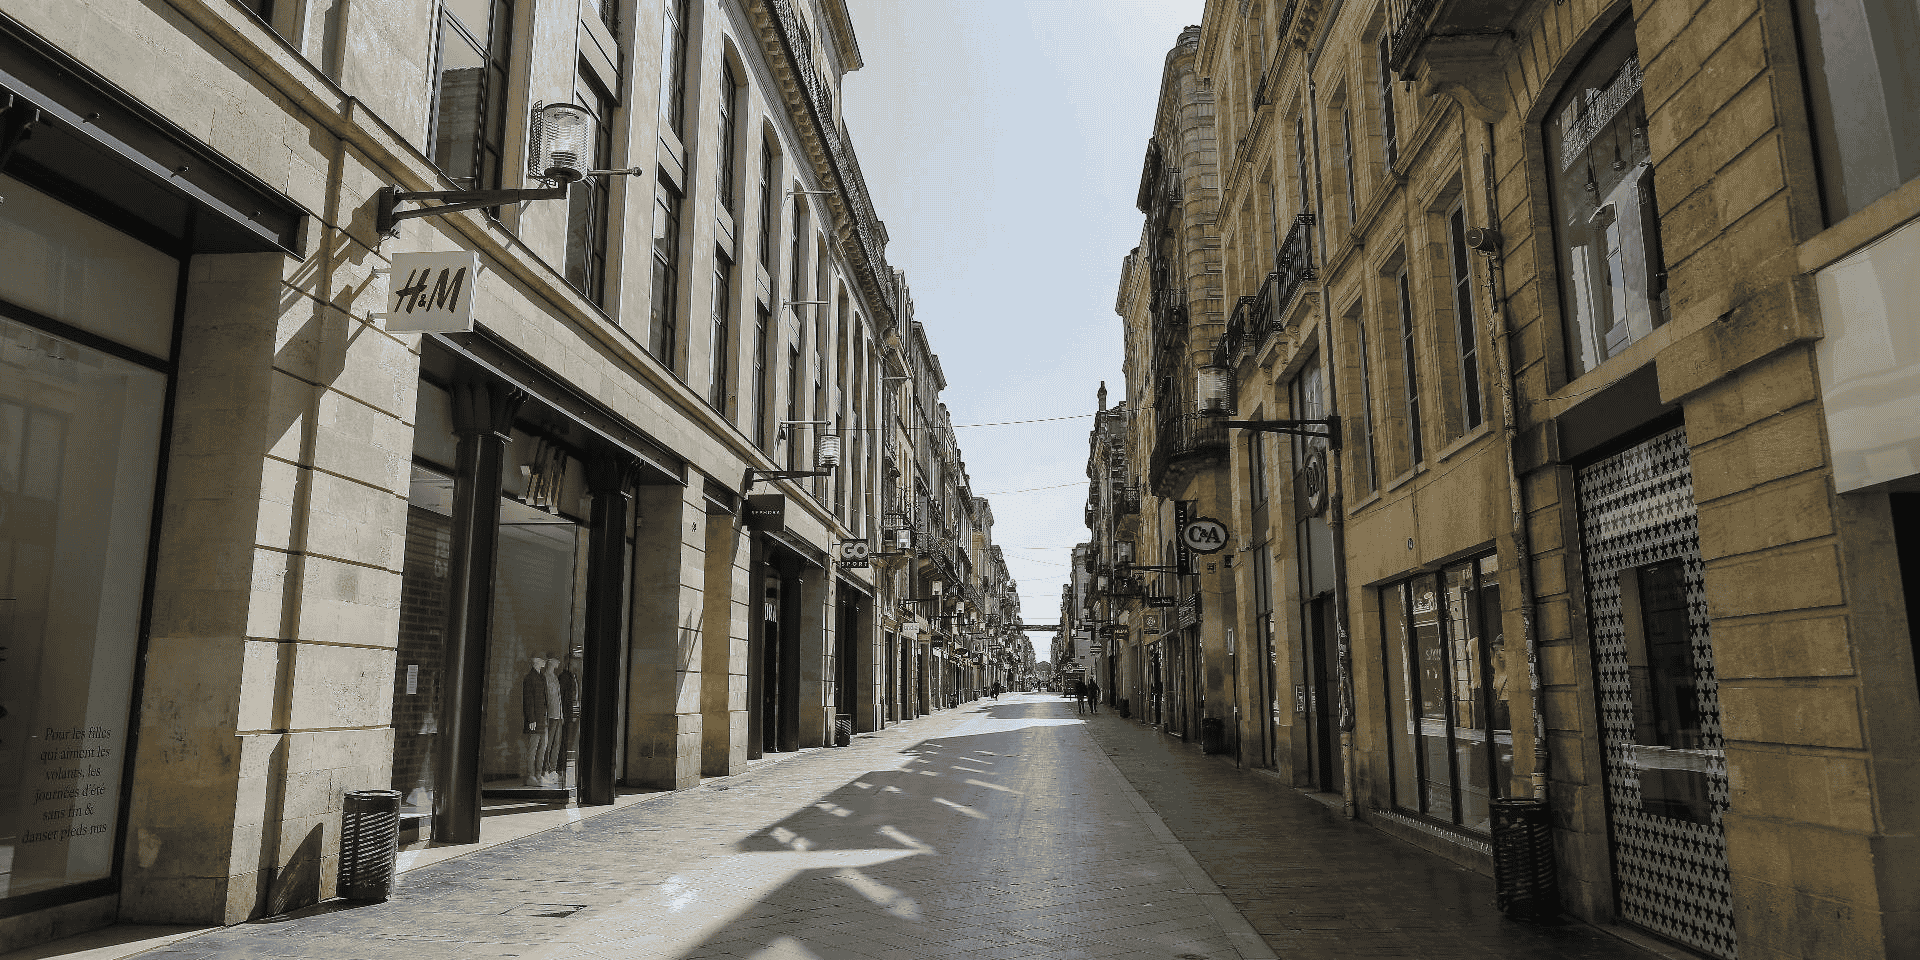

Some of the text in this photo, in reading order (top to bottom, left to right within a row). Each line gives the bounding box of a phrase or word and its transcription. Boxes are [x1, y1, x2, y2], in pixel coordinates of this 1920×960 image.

[394, 266, 467, 314] H&M
[1188, 525, 1221, 543] C&A
[841, 542, 869, 559] GO
[45, 726, 111, 740] Pour les filles
[40, 745, 110, 764] qui aiment les
[88, 764, 101, 777] les
[43, 802, 94, 821] sans fin &
[22, 823, 107, 844] danser pieds nus
